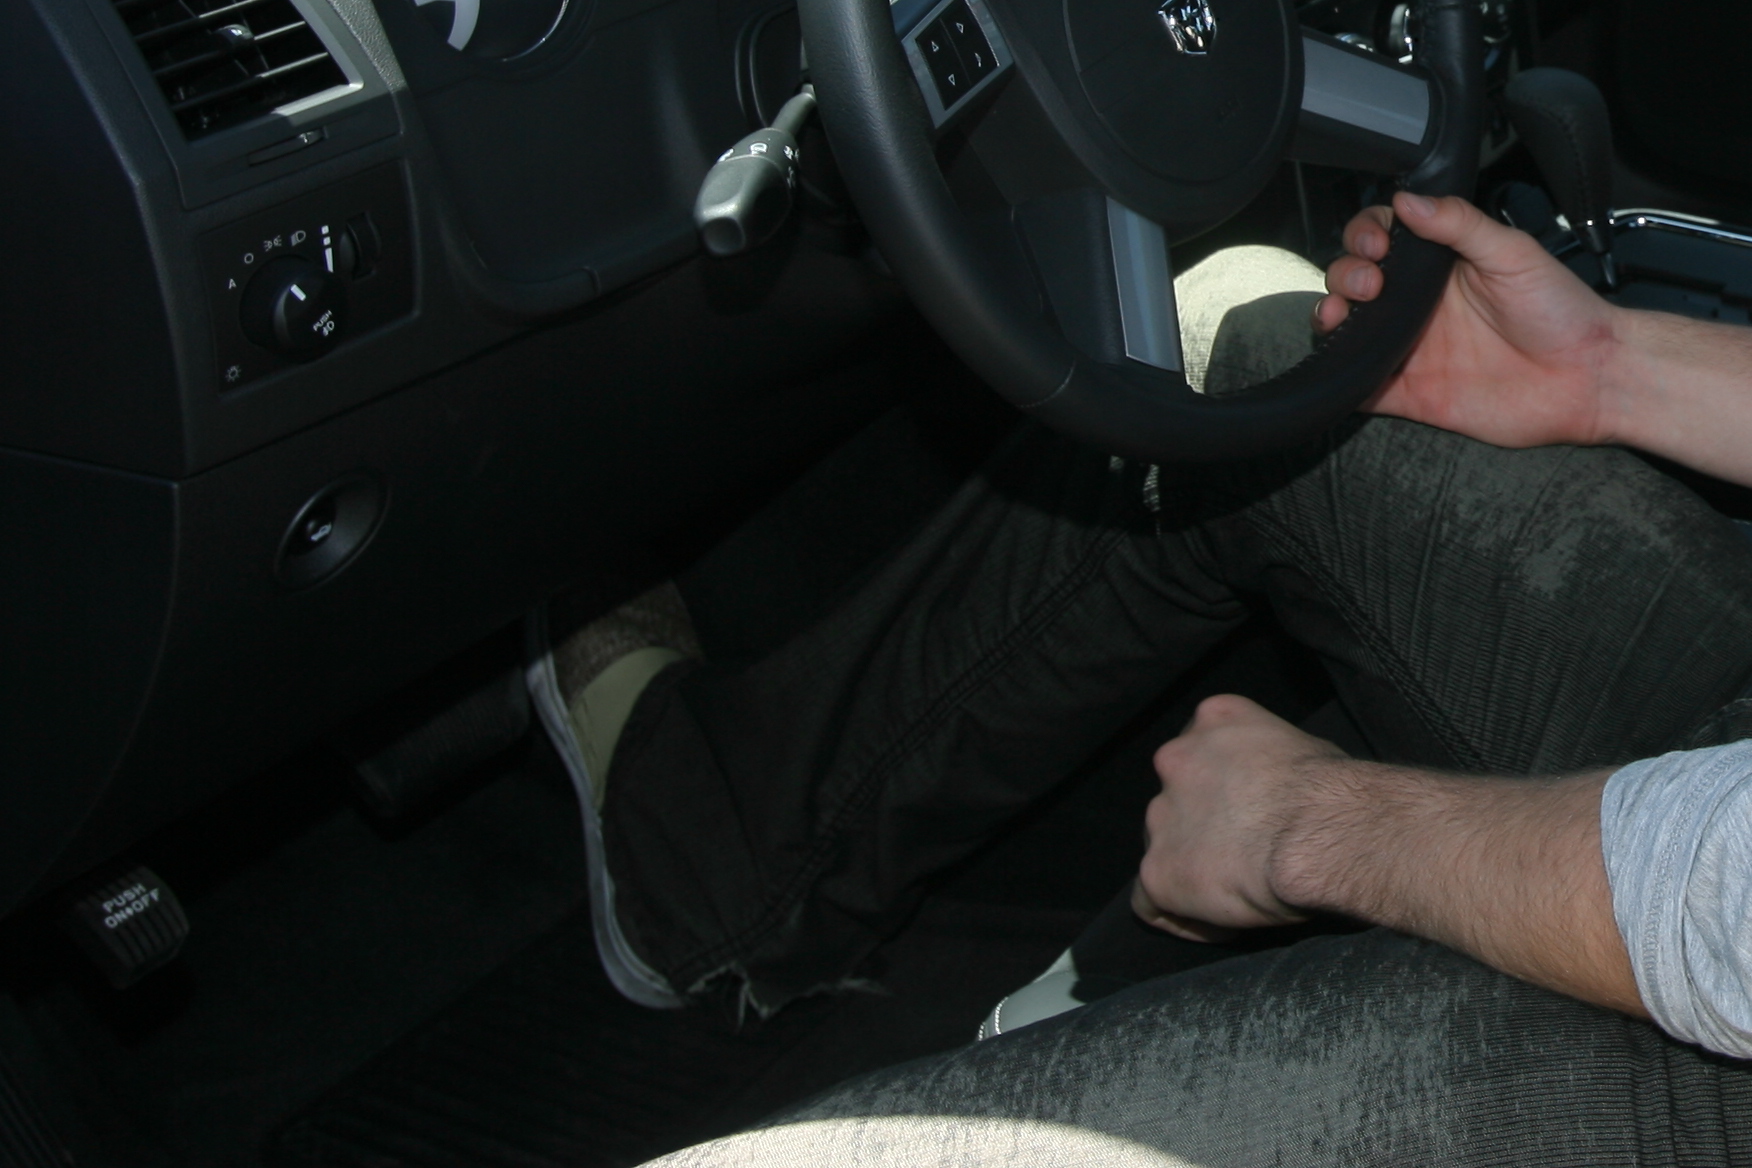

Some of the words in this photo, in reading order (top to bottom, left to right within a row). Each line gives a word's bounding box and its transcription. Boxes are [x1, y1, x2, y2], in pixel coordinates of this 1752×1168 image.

[228, 278, 237, 290] A
[312, 309, 333, 332] PUSH
[102, 882, 147, 914] PUSH
